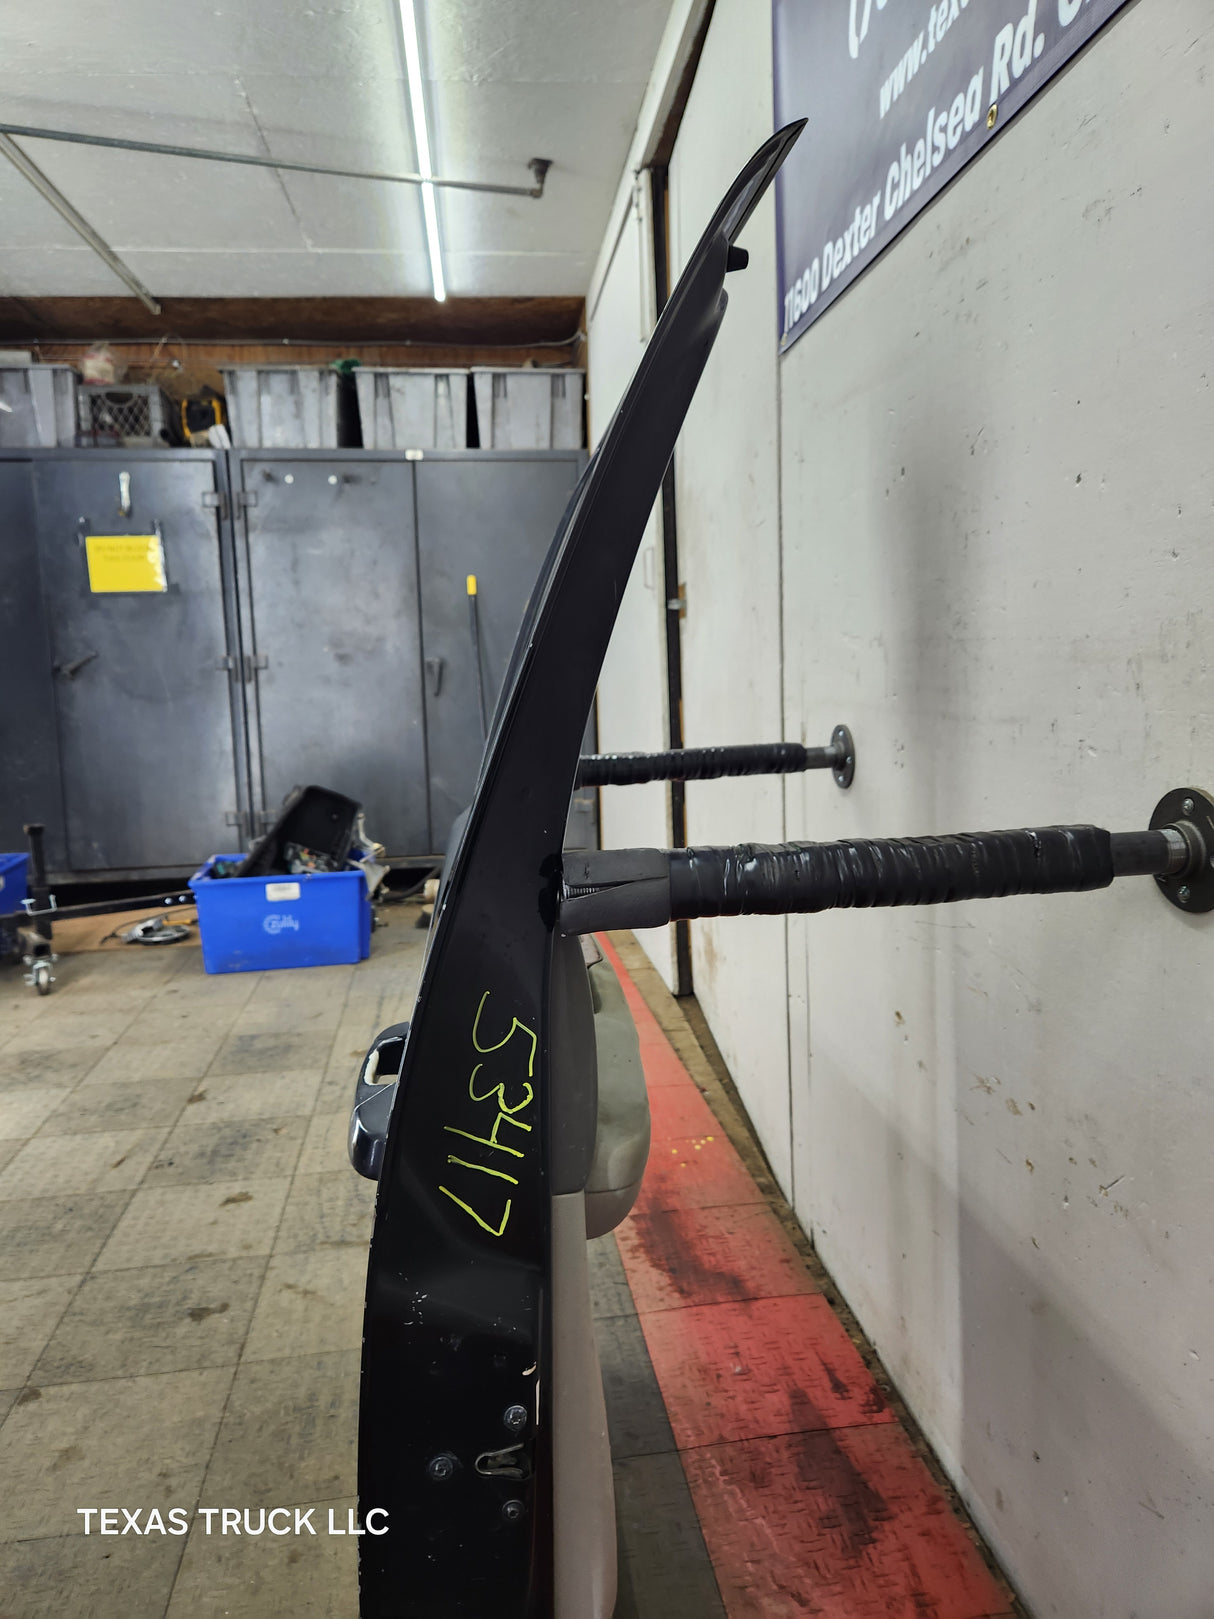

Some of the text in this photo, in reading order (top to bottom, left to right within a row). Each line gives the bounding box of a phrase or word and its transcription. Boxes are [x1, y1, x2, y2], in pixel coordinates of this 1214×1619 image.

[784, 0, 1045, 333] 11600 Dexter Chelsea Rd.
[880, 0, 969, 119] www.tex
[438, 990, 538, 1237] 53417
